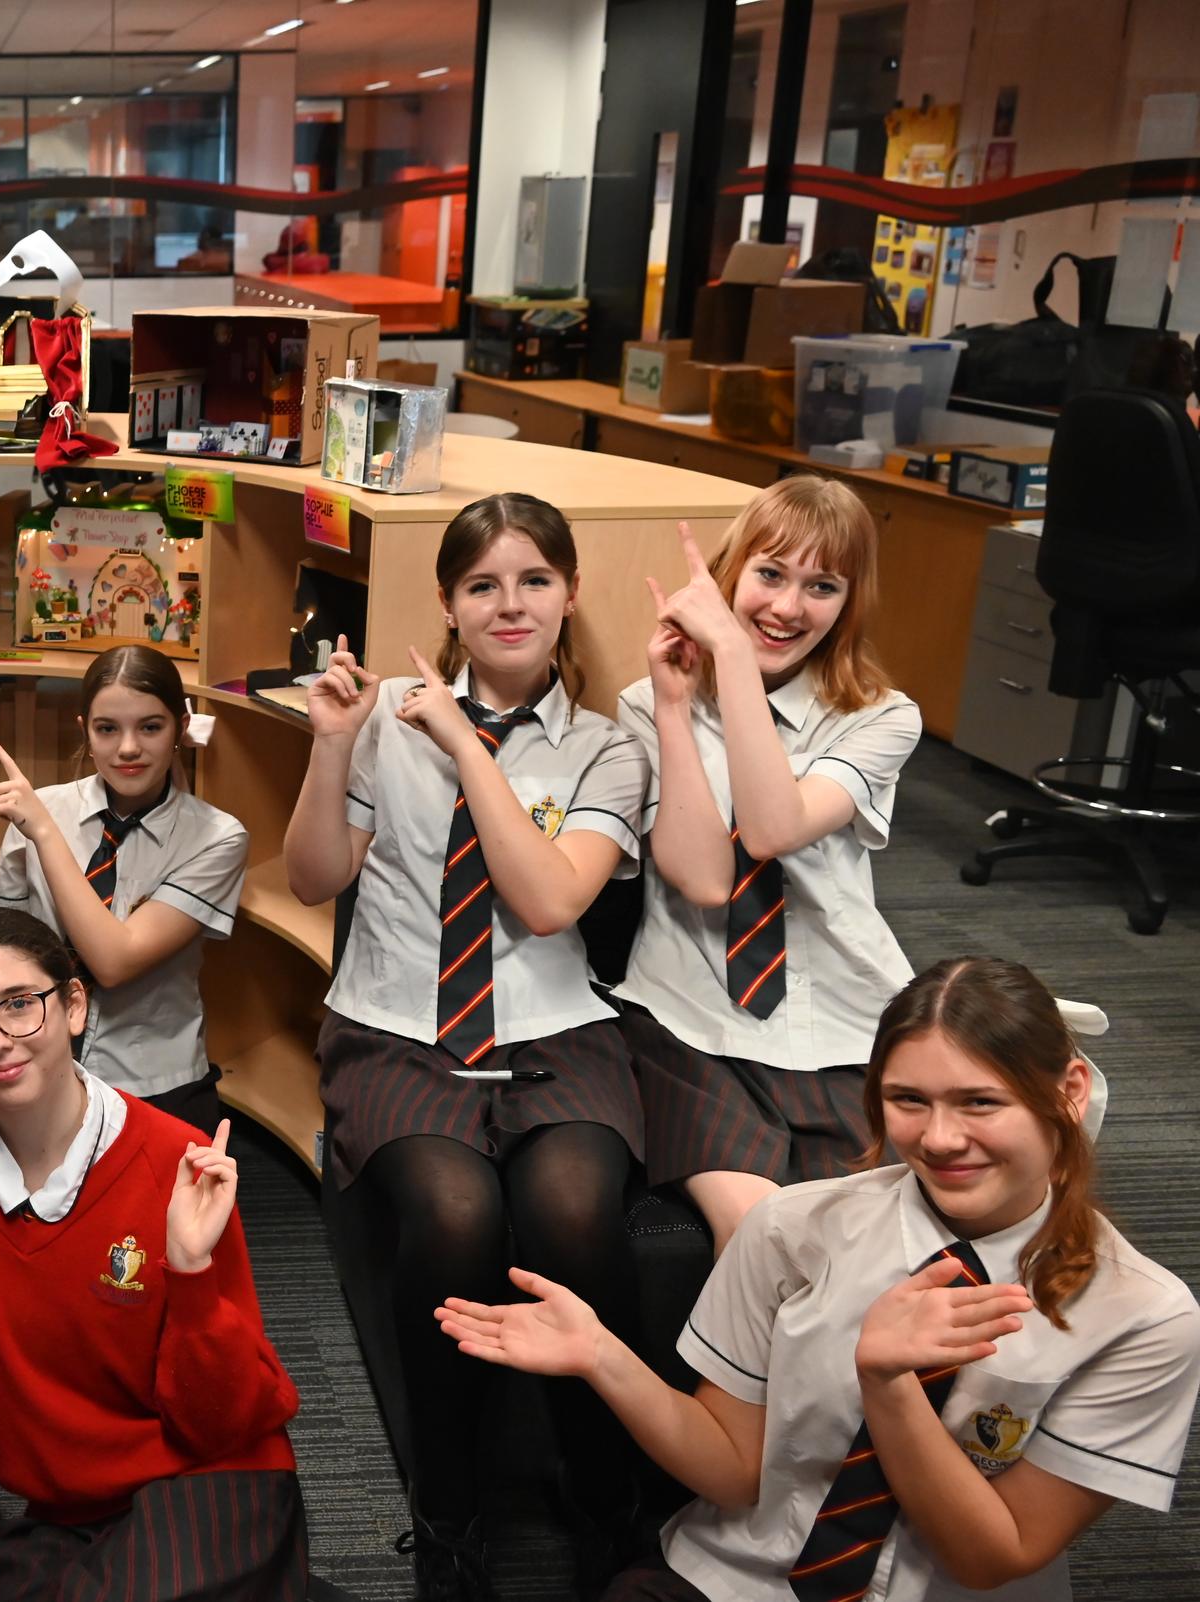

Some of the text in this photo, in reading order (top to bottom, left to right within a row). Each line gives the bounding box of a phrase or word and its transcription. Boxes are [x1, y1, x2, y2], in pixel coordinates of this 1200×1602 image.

[312, 357, 326, 430] Seasol
[168, 484, 206, 498] PHOEBE
[306, 498, 333, 517] SOPHIE
